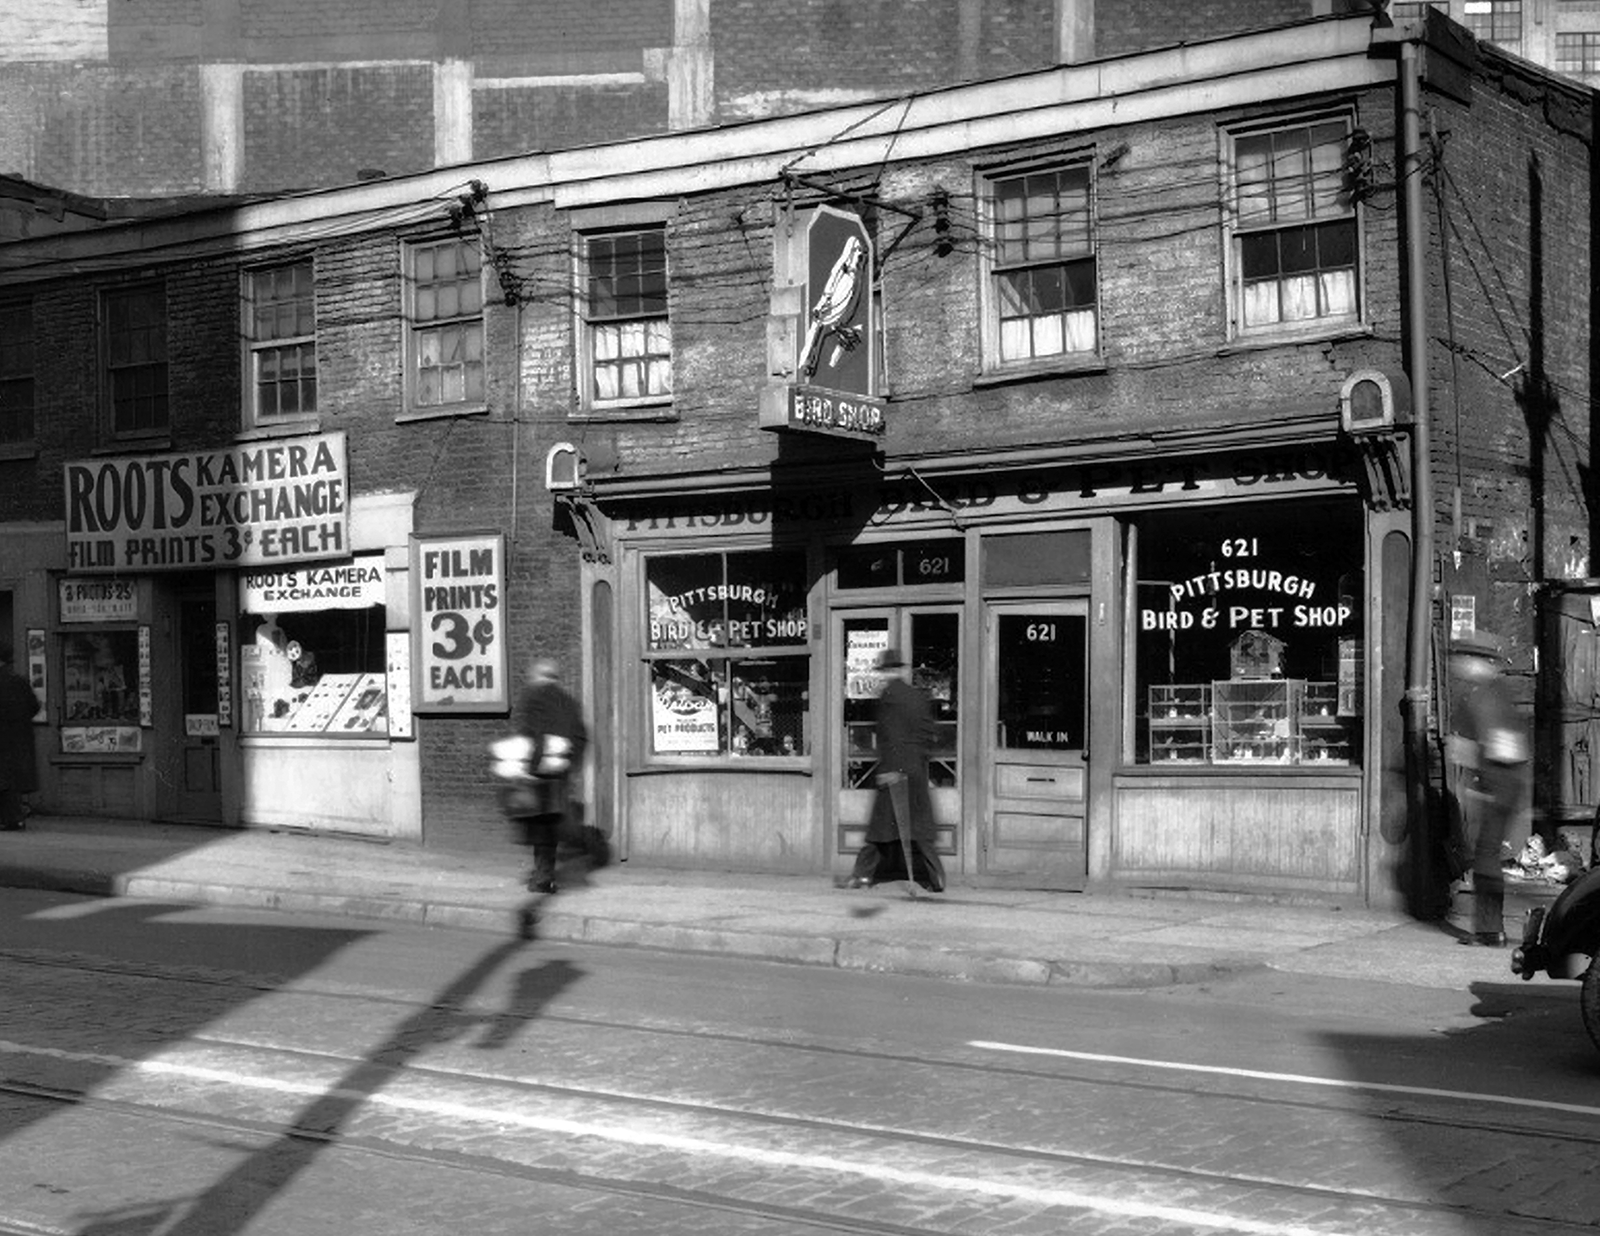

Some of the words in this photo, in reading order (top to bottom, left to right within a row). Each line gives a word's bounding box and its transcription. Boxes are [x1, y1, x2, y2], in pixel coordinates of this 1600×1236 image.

[795, 395, 833, 424] BIRD
[838, 401, 881, 430] SHOP
[68, 458, 195, 533] ROOTS
[196, 441, 337, 487] KAMERA
[200, 479, 344, 527] EXCHANGE
[70, 539, 116, 568] FILM
[125, 534, 216, 566] PRINTS
[223, 527, 253, 561] 3¢
[259, 521, 343, 558] EACH
[1221, 538, 1259, 558] 621
[306, 566, 382, 586] KAMERA
[424, 548, 494, 579] FILM
[920, 557, 949, 575] 621
[263, 586, 362, 601] EXCHANGE
[424, 583, 499, 612] PRINTS
[1170, 569, 1316, 602] PITTSBURGH
[669, 584, 779, 615] PITTSBURGH
[651, 620, 690, 640] BIRD
[729, 620, 763, 639] PET
[766, 618, 808, 638] SHOP
[1142, 609, 1195, 630] BIRD
[1201, 607, 1219, 628] &
[1229, 606, 1284, 628] PET
[1294, 605, 1350, 627] SHOP
[430, 611, 495, 660] 3¢
[1026, 623, 1057, 641] 621
[430, 665, 494, 690] EACH
[1026, 731, 1054, 742] WALK
[1056, 731, 1069, 743] IN
